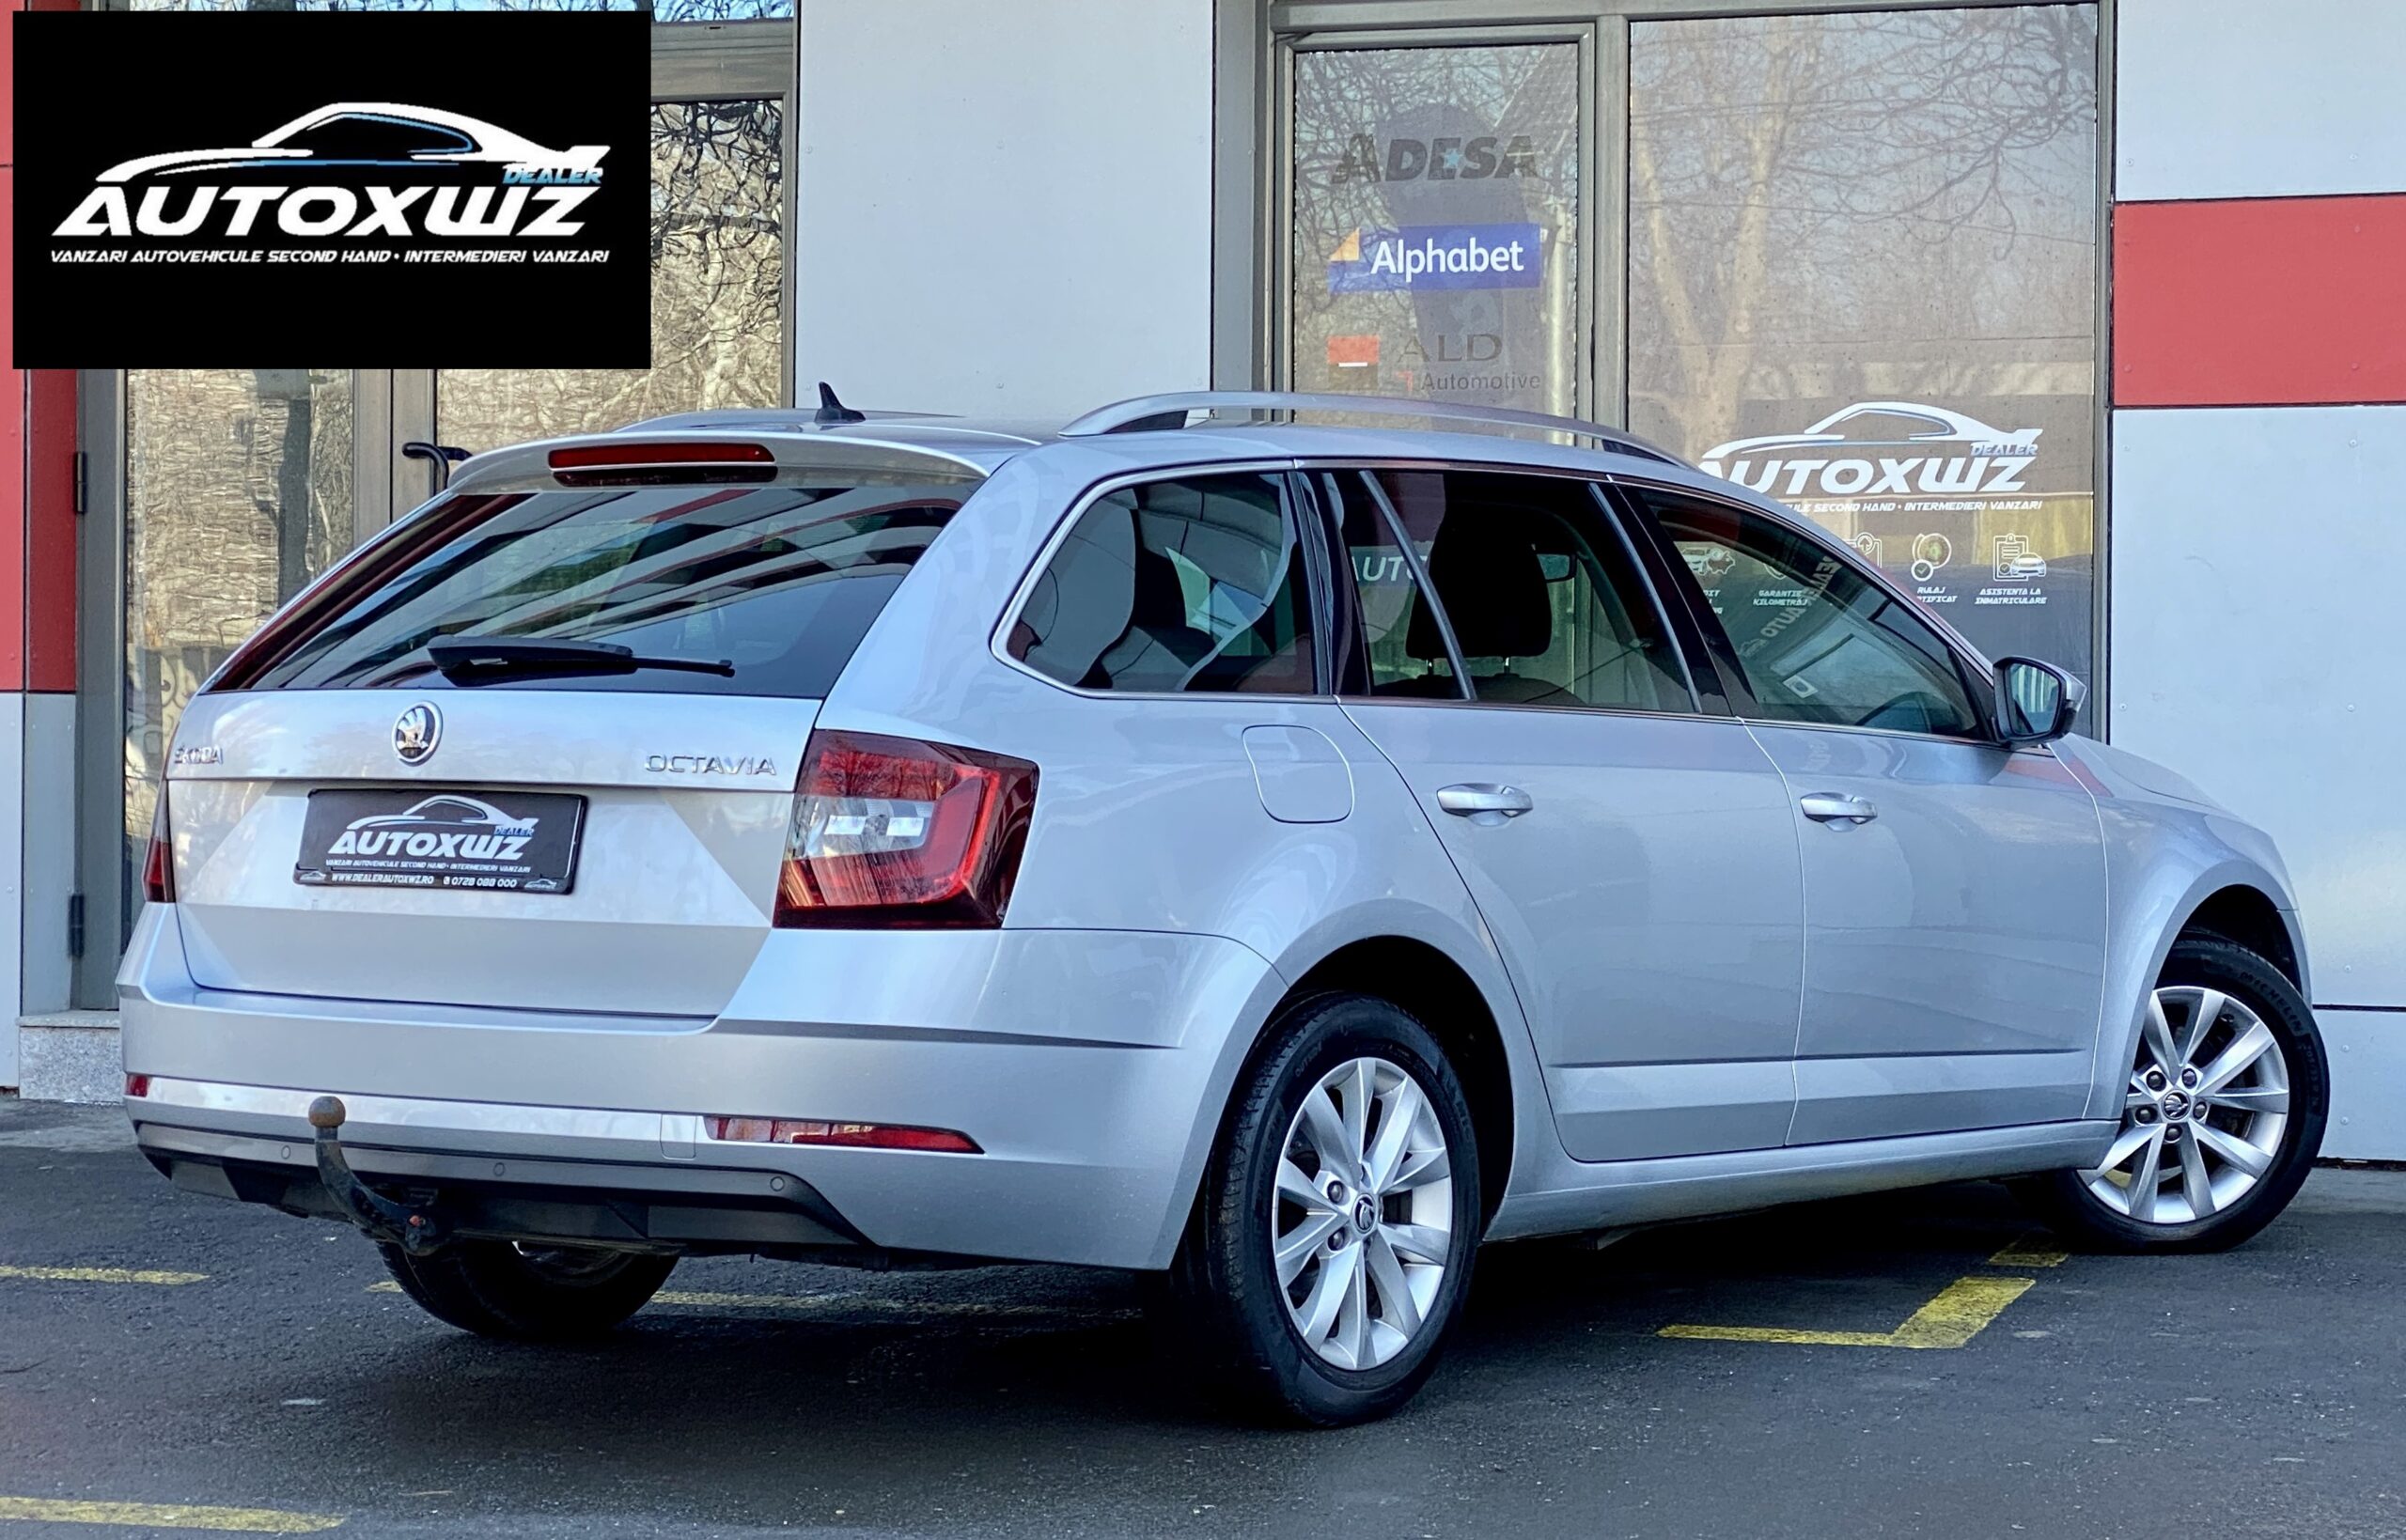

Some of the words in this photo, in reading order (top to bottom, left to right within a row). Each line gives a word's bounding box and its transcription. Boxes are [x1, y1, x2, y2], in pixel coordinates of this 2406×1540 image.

[1331, 134, 1538, 183] ADESA
[1370, 237, 1524, 283] Alphabet
[1397, 334, 1503, 363] ALD
[1421, 371, 1541, 392] Automotive
[1970, 443, 2039, 457] DEALER
[1814, 502, 1860, 512] SECOND
[1862, 502, 1896, 512] HAND
[1904, 501, 1988, 512] INTERMEDIERI
[1990, 500, 2043, 511] VANZARI
[1916, 585, 1946, 594] RULAJ
[1979, 587, 2028, 596] ASISTENTA
[2029, 587, 2041, 596] LA
[1975, 597, 2048, 605] INMATRICULARE
[645, 754, 777, 776] OCTAVIA
[492, 825, 535, 836] DEALER
[327, 831, 532, 861] AUTOXWZ
[352, 860, 399, 868] AUTOVEHICULE
[450, 863, 498, 872] INTERMEDIERI
[499, 864, 531, 873] VANZARI
[2240, 972, 2303, 1031] MICHELIN
